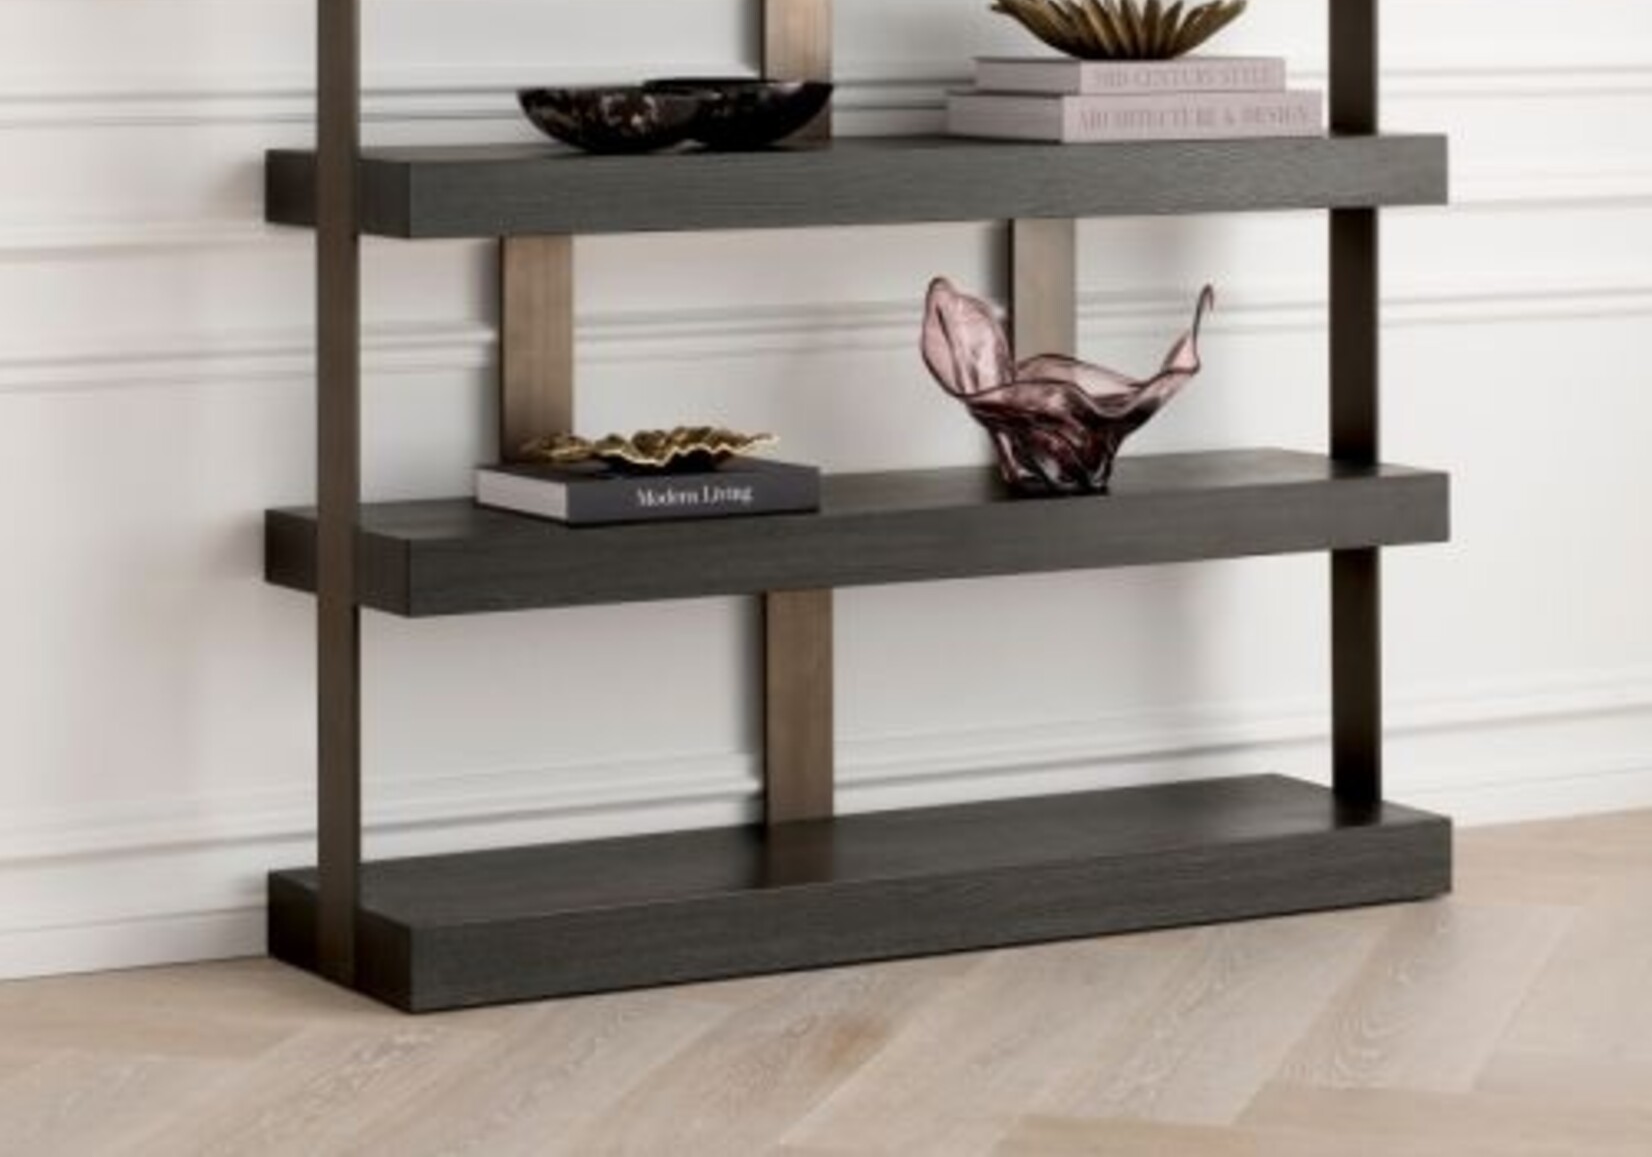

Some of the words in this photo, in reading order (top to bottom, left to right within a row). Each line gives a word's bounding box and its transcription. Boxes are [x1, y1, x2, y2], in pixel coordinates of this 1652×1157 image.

[1242, 105, 1308, 126] DESIGN
[636, 486, 699, 507] Modern
[703, 485, 754, 505] Living
